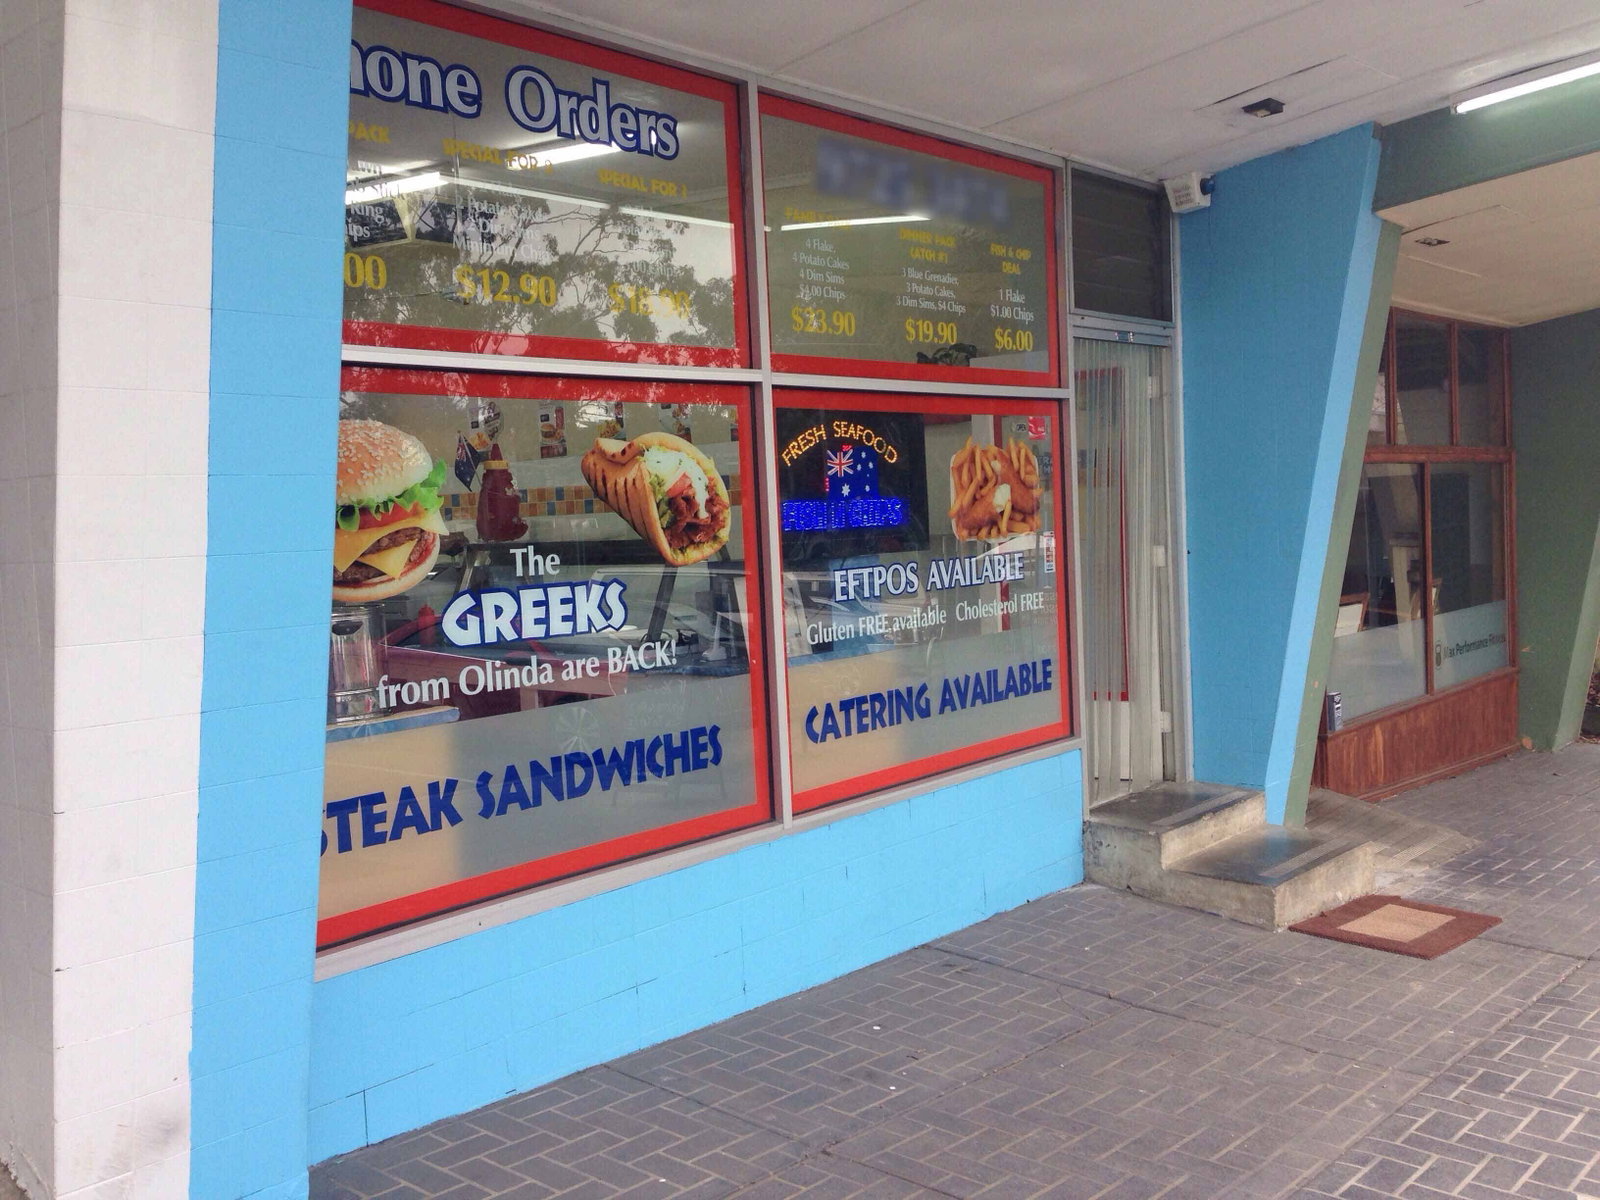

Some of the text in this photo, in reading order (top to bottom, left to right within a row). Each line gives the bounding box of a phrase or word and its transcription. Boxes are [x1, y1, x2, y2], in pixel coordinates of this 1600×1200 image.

[505, 65, 680, 160] Orders
[799, 252, 826, 267] Potato
[826, 256, 850, 270] Cakes
[806, 269, 825, 281] Dim
[825, 271, 845, 284] Sims
[907, 267, 924, 280] Blue
[454, 263, 557, 307] $12.90
[823, 286, 847, 302] Chips
[911, 282, 934, 296] Potato
[1005, 289, 1026, 304] Flake
[791, 304, 856, 337] $23.90
[902, 296, 918, 308] Dim
[947, 301, 967, 316] Chips
[990, 304, 1035, 324] $1.00 Chips
[905, 316, 958, 345] $19.90
[994, 325, 1034, 352] $6.00
[781, 420, 898, 467] FRESH SEAFOOD
[510, 546, 561, 577] The
[833, 561, 919, 603] EFTPOS
[926, 551, 1025, 591] AVAILABLE
[441, 577, 628, 648] GREEKS
[807, 623, 855, 646] Gluten
[858, 614, 889, 637] FREE
[893, 604, 947, 632] available
[955, 596, 1018, 622] Cholesterol
[1020, 592, 1045, 612] FREE
[376, 640, 678, 709] from Olinda are BACK!
[805, 658, 1052, 744] CATERING AVAILABLE
[320, 724, 723, 857] TEAK SANDWICHES
